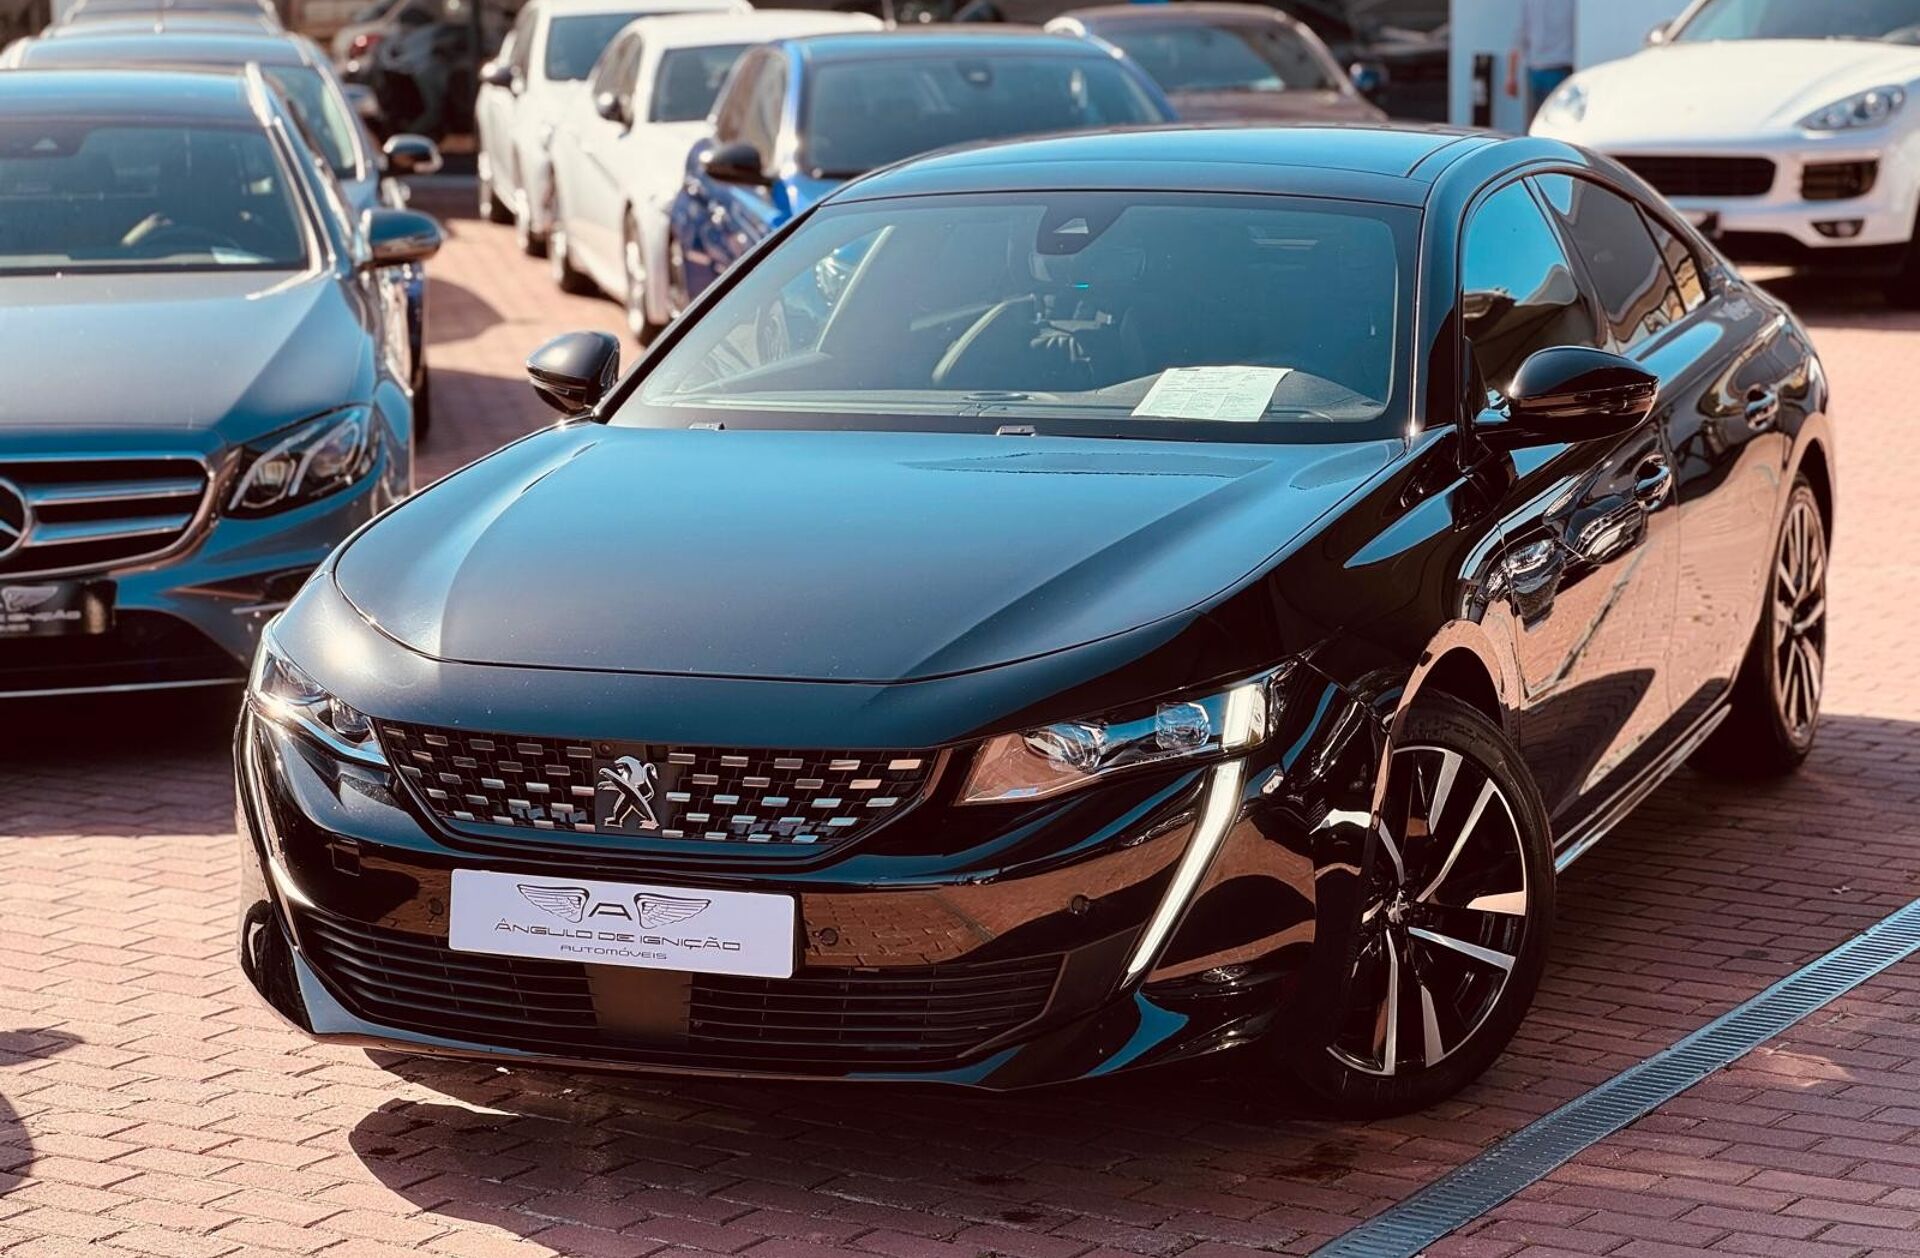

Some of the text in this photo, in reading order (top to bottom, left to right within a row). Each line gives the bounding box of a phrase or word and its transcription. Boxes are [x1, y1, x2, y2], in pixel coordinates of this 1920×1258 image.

[588, 902, 632, 921] A
[494, 918, 741, 951] ÂNGULO DE IGNIÇÃO
